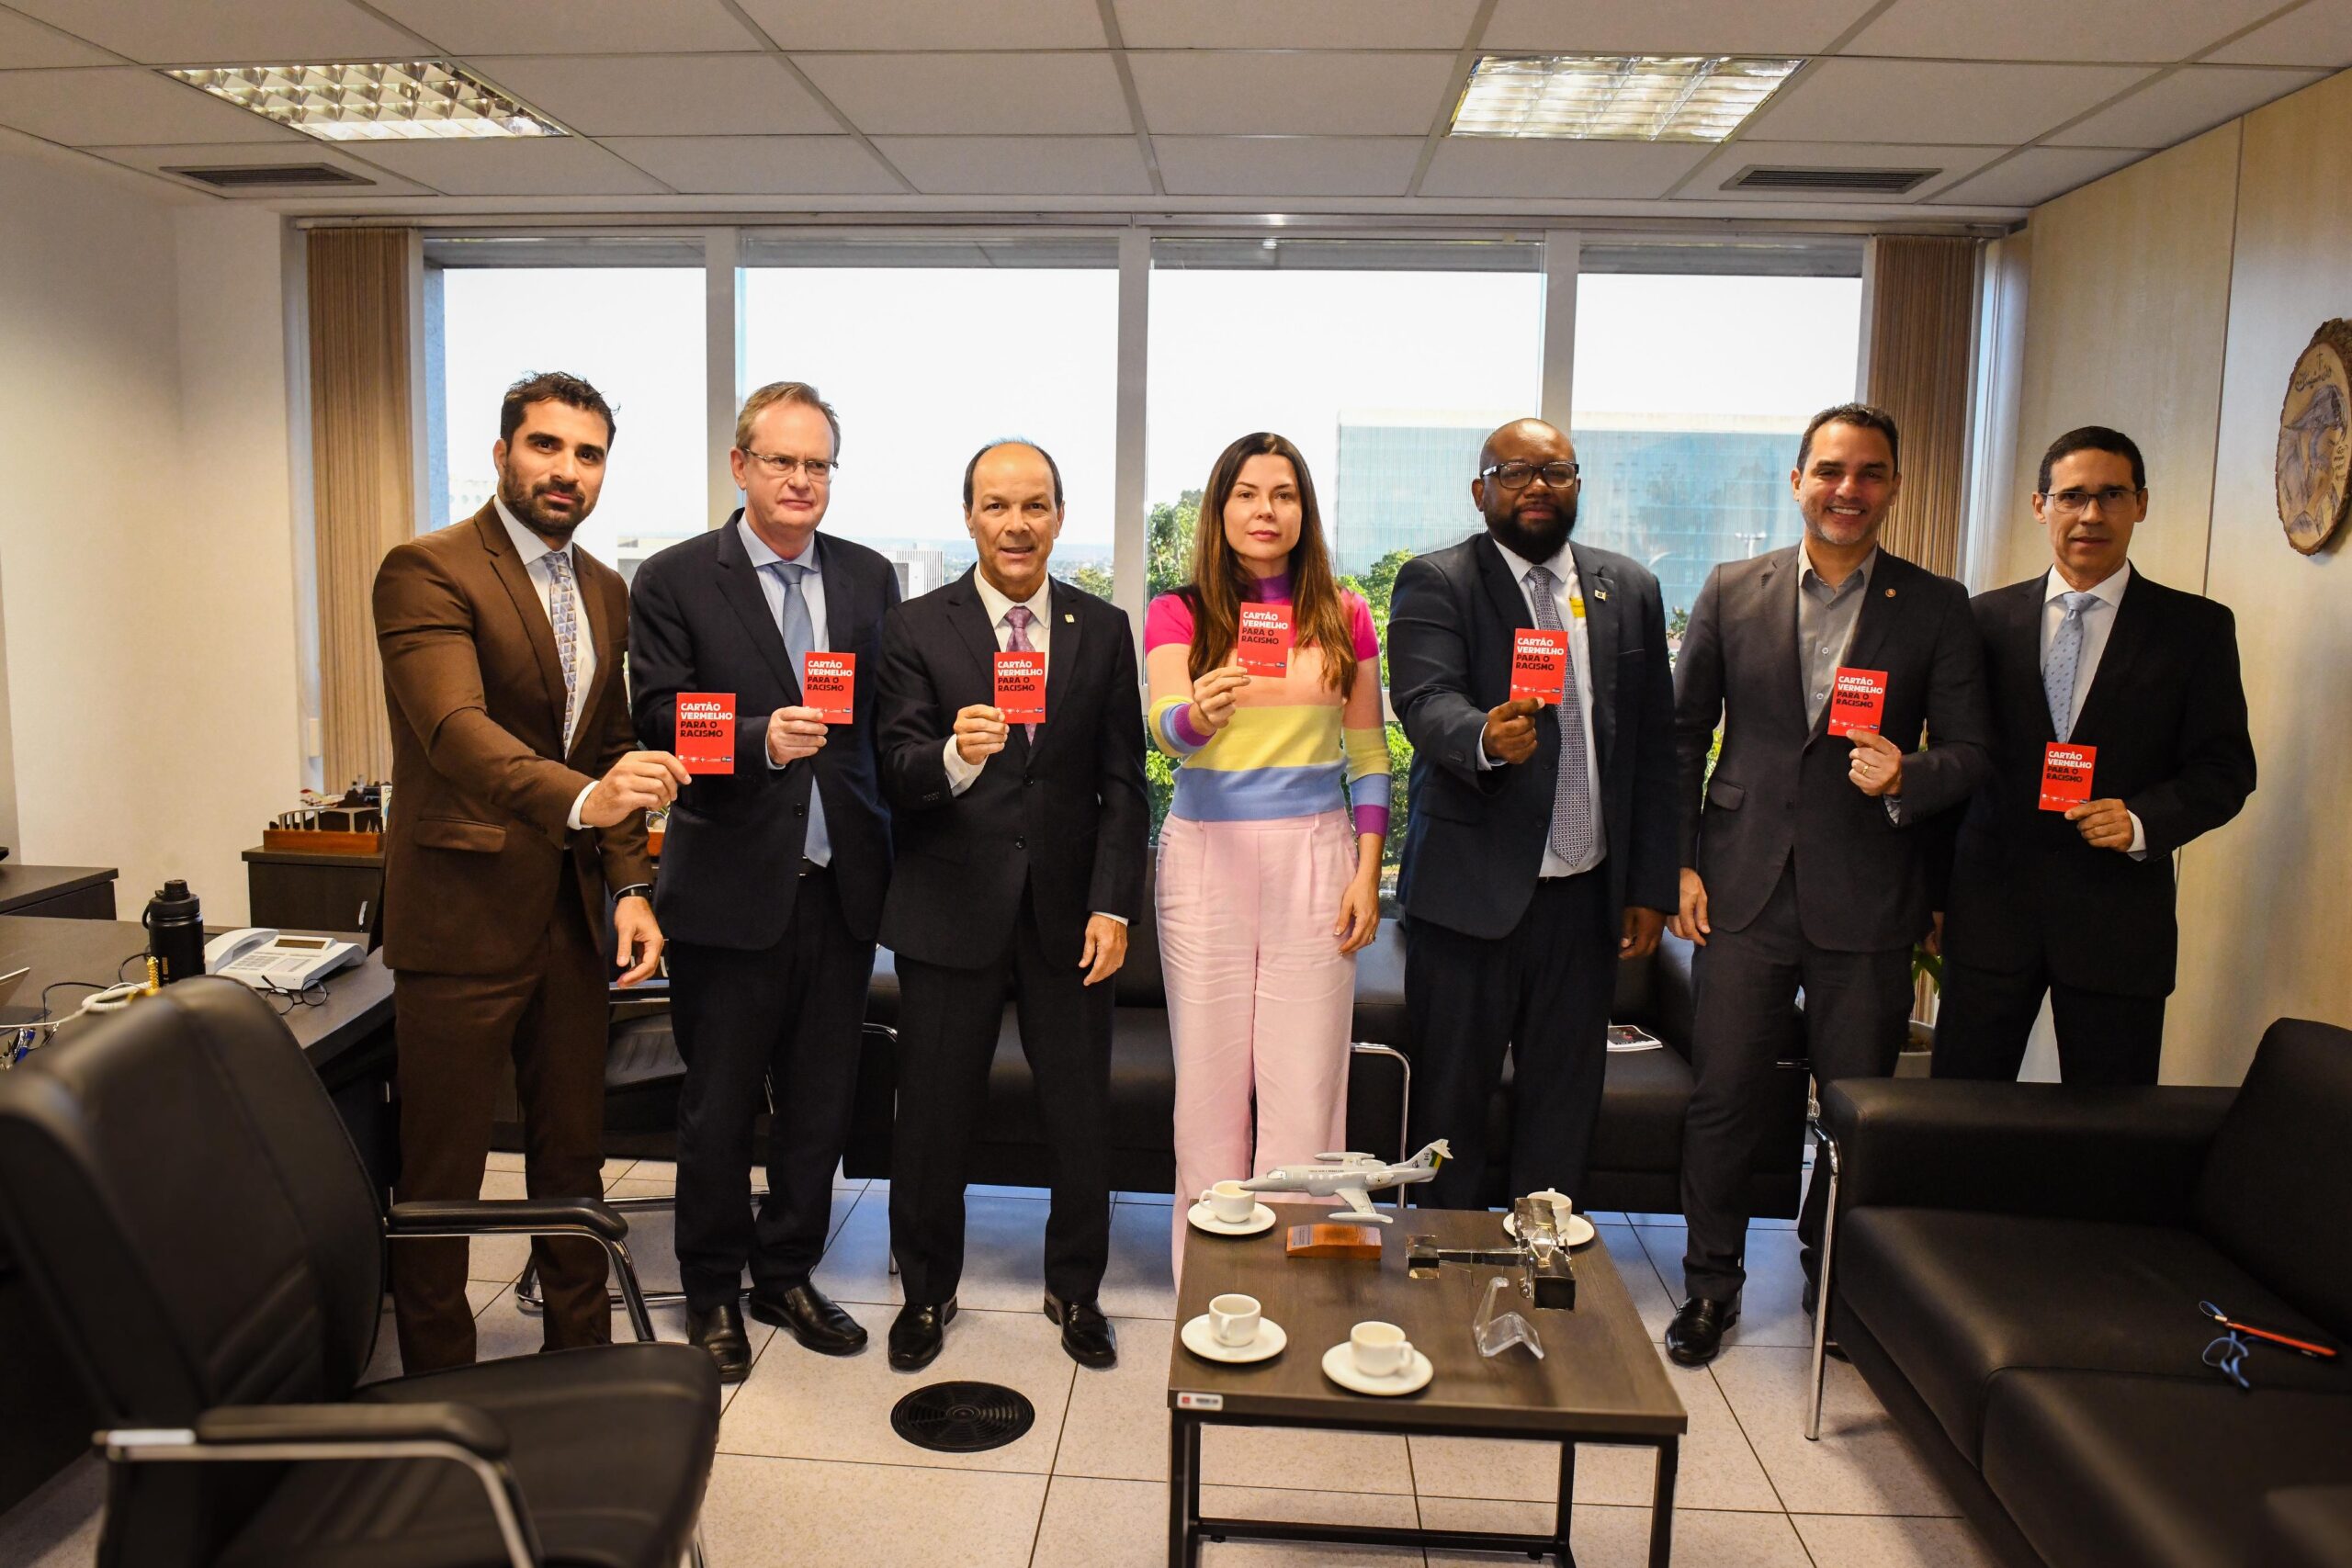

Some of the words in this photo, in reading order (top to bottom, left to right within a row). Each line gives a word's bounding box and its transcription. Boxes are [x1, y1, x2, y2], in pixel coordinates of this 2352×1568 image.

[1243, 612, 1278, 621] CARTÃO
[1242, 619, 1288, 629] VERMELHO
[1242, 627, 1265, 636] PARA
[1241, 636, 1279, 645] RACISMO
[1517, 637, 1554, 647] CARTÃO
[1517, 646, 1564, 655] VERMELHO
[808, 660, 842, 669] CARTÃO
[997, 660, 1033, 669] CARTÃO
[1515, 661, 1555, 671] RACISMO
[808, 669, 853, 677] VERMELHO
[1838, 676, 1873, 686] CARTÃO
[807, 683, 844, 692] RACISMO
[1838, 683, 1883, 694] VERMELHO
[1837, 691, 1860, 699] PARA
[681, 702, 721, 711] CARTÃO
[1836, 698, 1873, 708] RACISMO
[681, 712, 733, 720] VERMELHO
[680, 729, 723, 738] RACISMO
[2048, 750, 2083, 761] CARTÃO
[2047, 758, 2092, 769] VERMELHO
[2047, 766, 2069, 774] PARA
[2046, 773, 2083, 783] RACISMO
